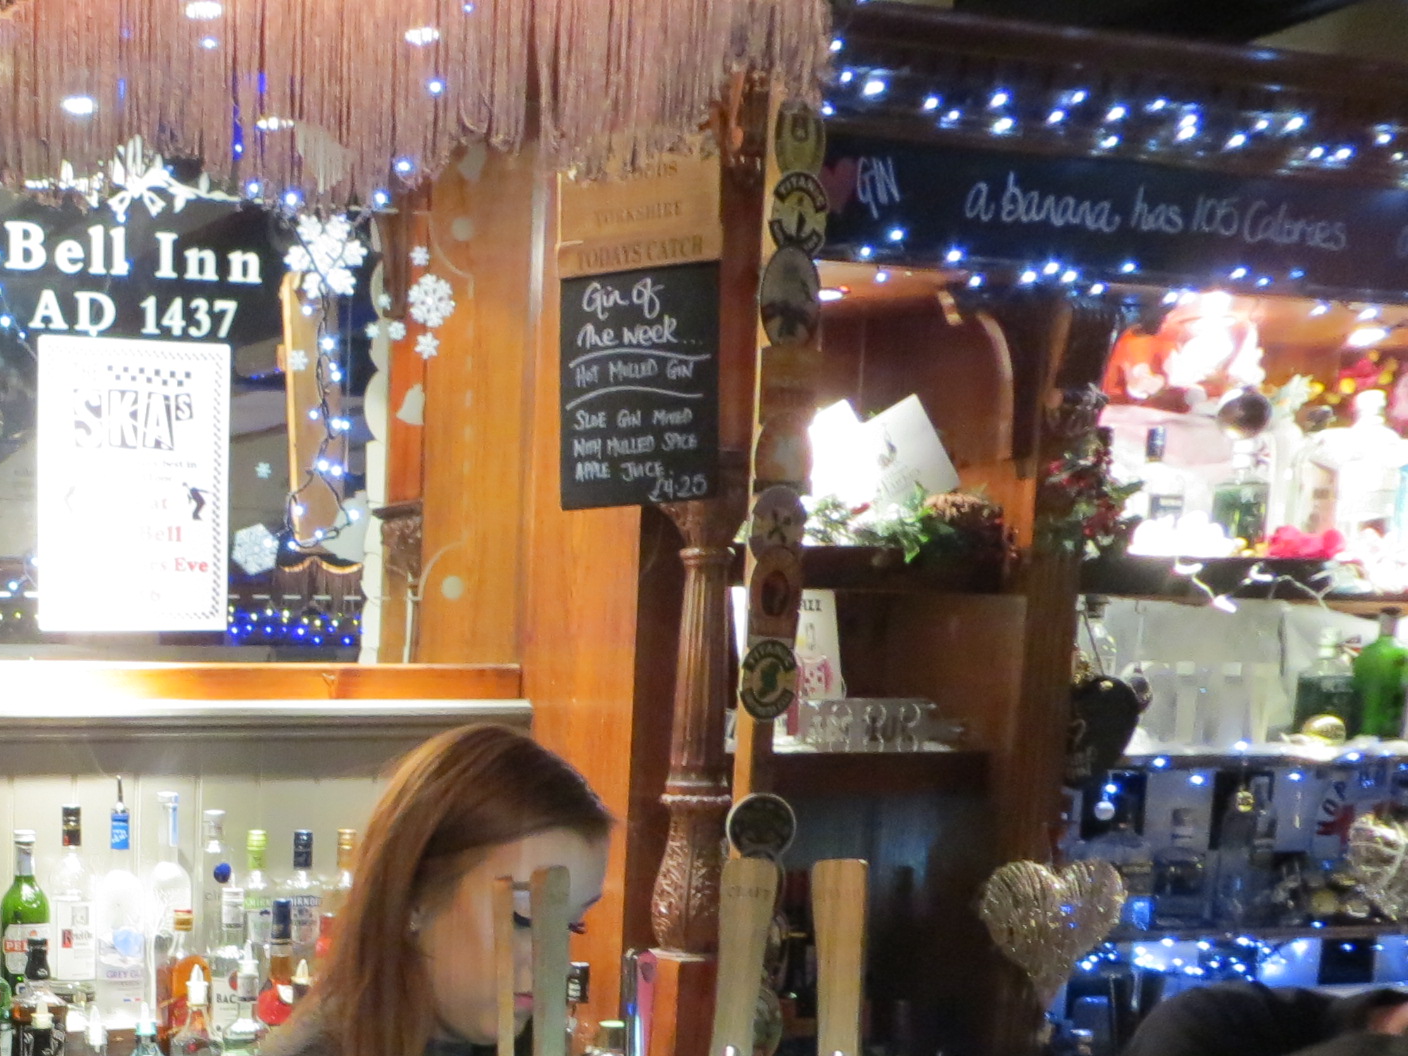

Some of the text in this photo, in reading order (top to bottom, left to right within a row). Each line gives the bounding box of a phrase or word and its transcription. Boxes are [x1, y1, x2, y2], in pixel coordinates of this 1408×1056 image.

[965, 181, 994, 223] a
[1001, 170, 1121, 233] banana
[1130, 184, 1184, 233] has
[4, 220, 263, 285] Bell Inn
[29, 288, 238, 338] AD 1437
[582, 280, 630, 321] Gin
[174, 556, 209, 573] Eve
